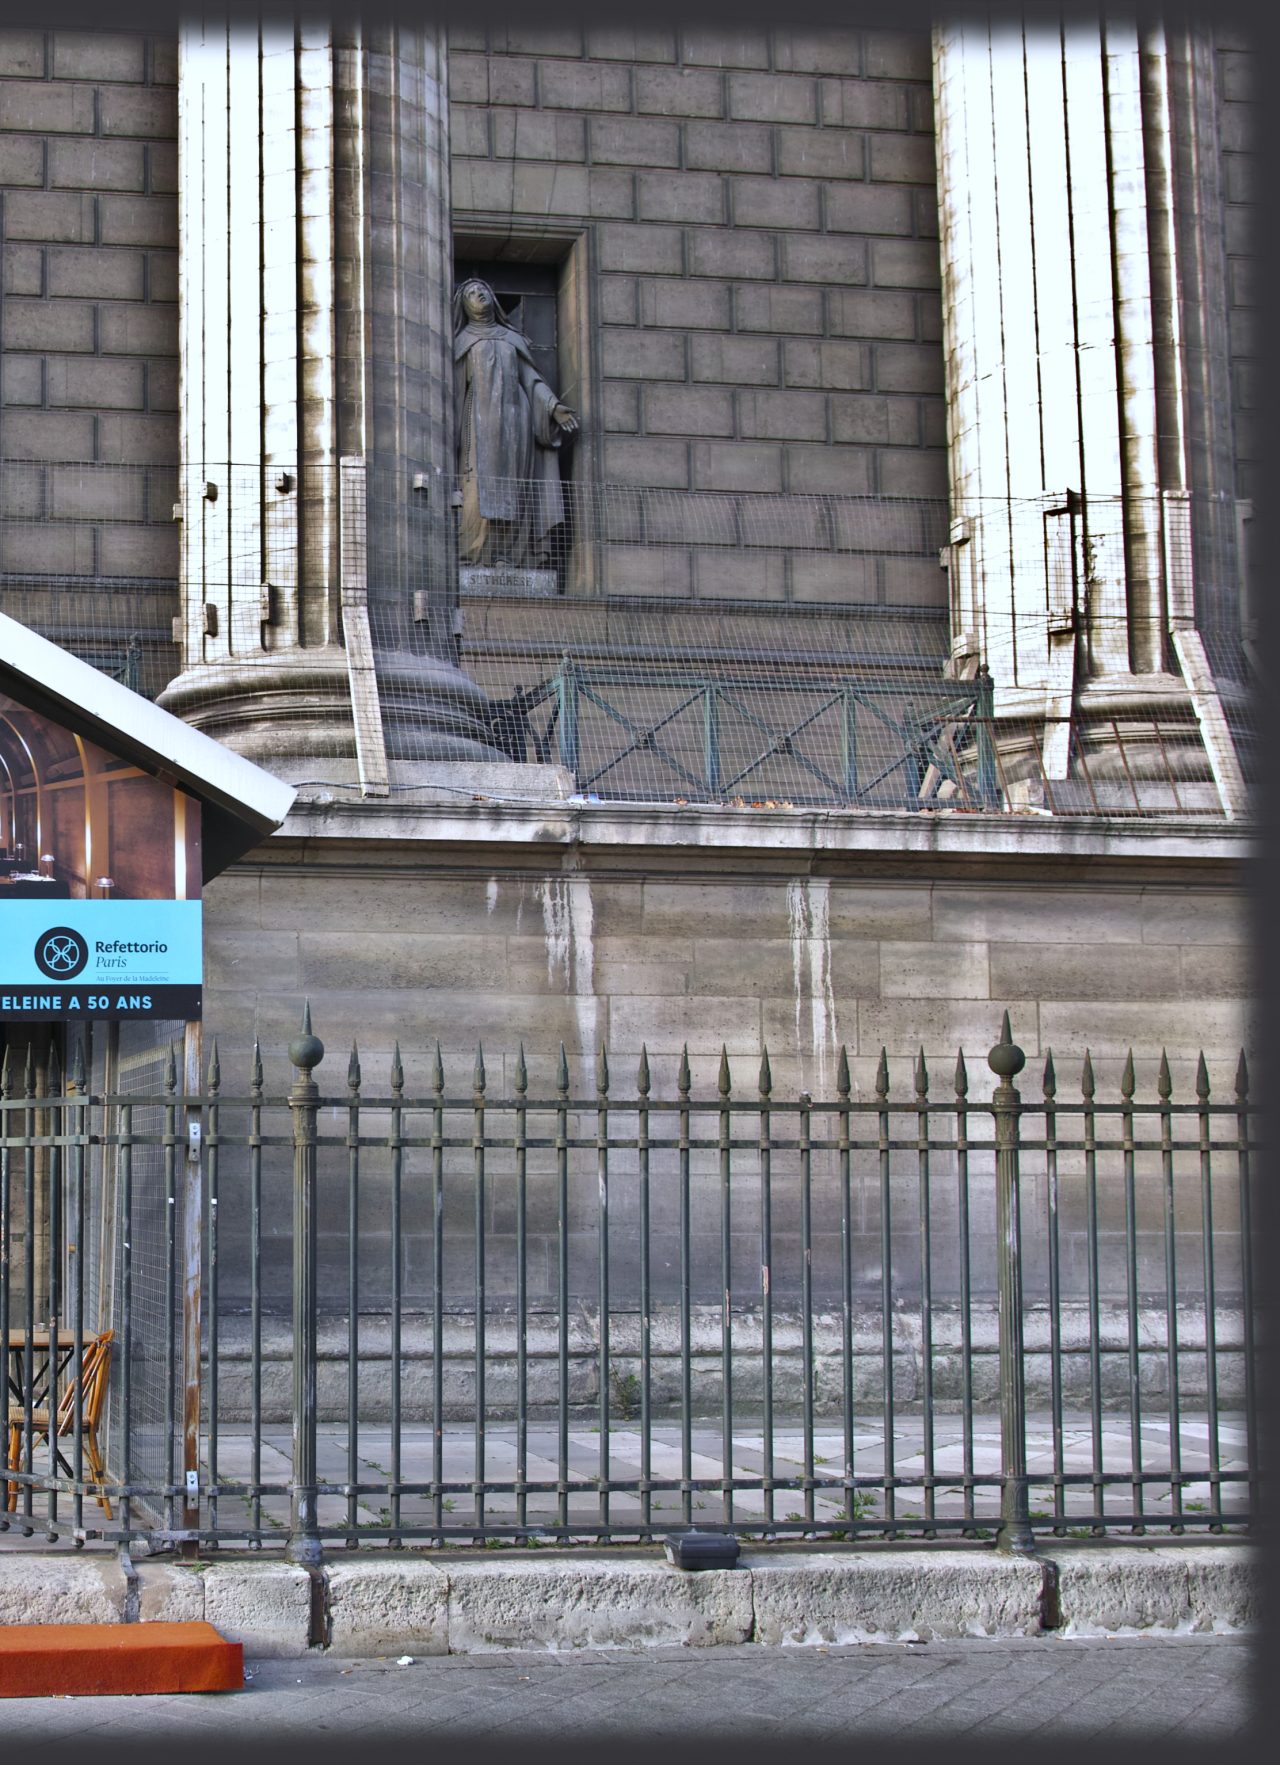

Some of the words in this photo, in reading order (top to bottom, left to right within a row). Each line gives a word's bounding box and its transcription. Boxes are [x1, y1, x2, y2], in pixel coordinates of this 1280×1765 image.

[95, 940, 168, 953] Refettorio
[95, 955, 128, 968] Paris
[106, 975, 122, 983] Foyer
[68, 996, 81, 1010] A
[87, 996, 110, 1010] 50
[115, 996, 153, 1010] ANS
